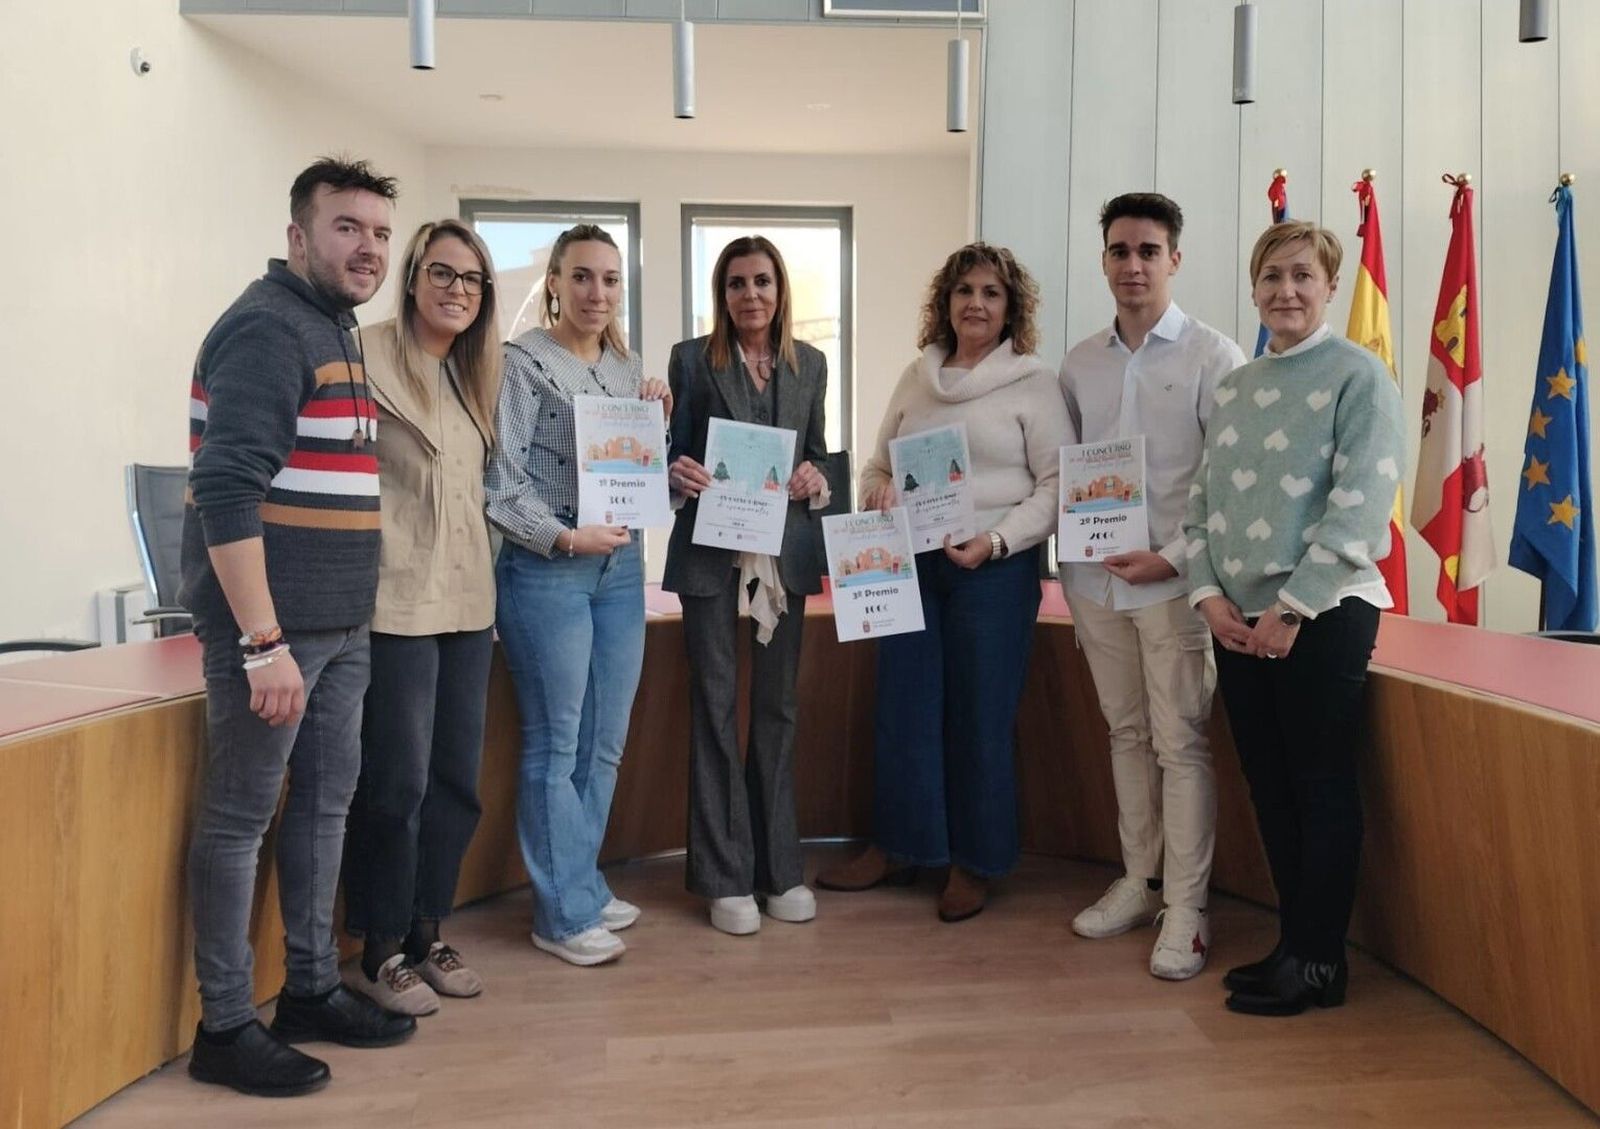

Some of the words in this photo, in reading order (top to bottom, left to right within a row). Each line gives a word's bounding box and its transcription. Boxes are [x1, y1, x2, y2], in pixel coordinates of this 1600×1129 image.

[610, 479, 646, 488] Premio
[1093, 514, 1128, 525] Premio
[864, 587, 899, 598] Premio
